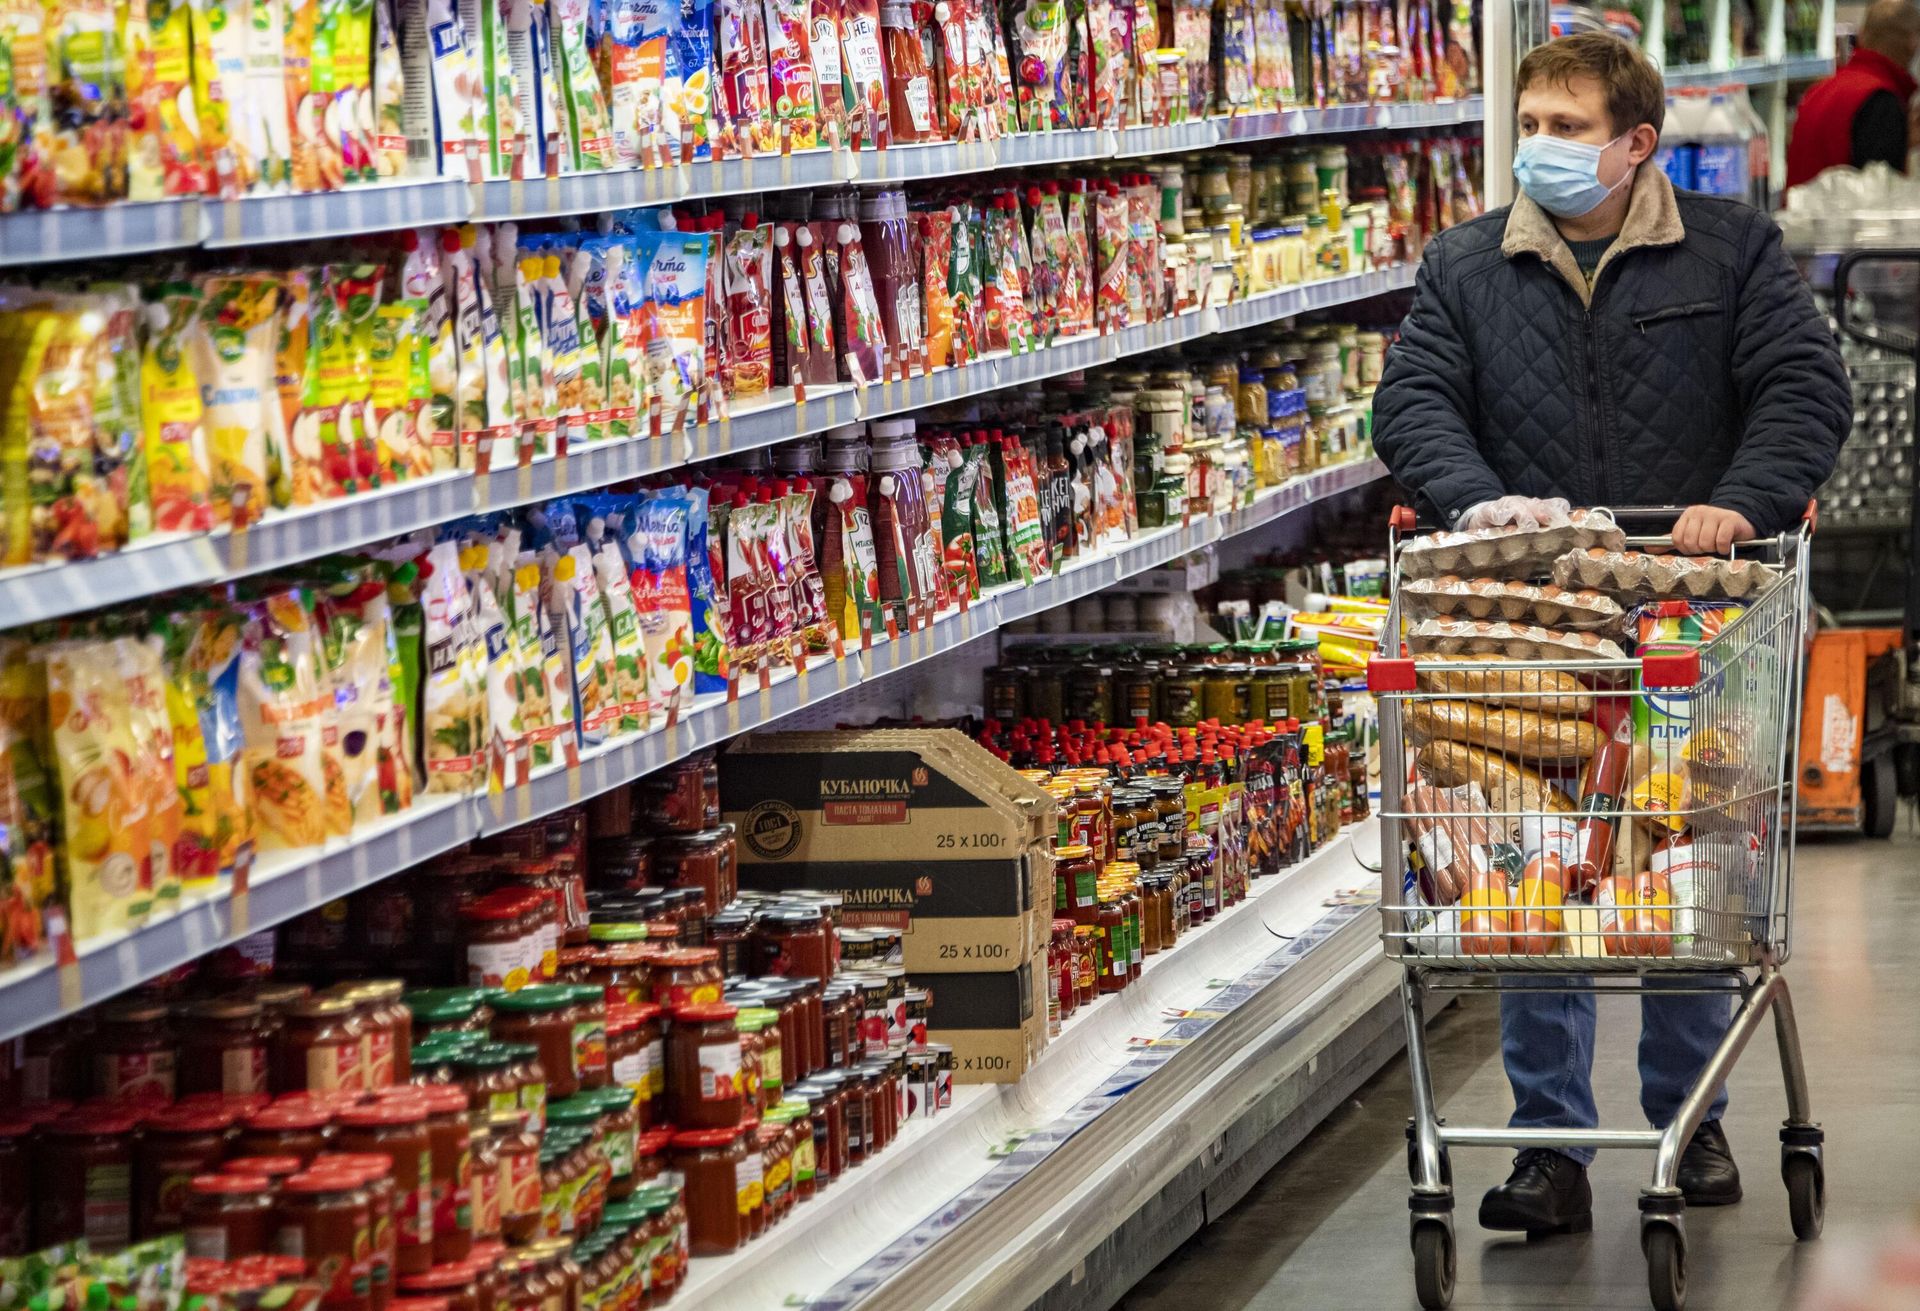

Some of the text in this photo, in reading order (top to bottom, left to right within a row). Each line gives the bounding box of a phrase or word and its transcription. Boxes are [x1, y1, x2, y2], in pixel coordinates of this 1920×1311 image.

[820, 779, 910, 795] КУБАНОЧКА
[834, 804, 897, 815] ПАСТА ТОМАТНАЯ
[936, 835, 955, 848] 25
[838, 887, 913, 903] БАНОЧКА
[841, 911, 859, 923] АСТА
[940, 944, 958, 958] 25
